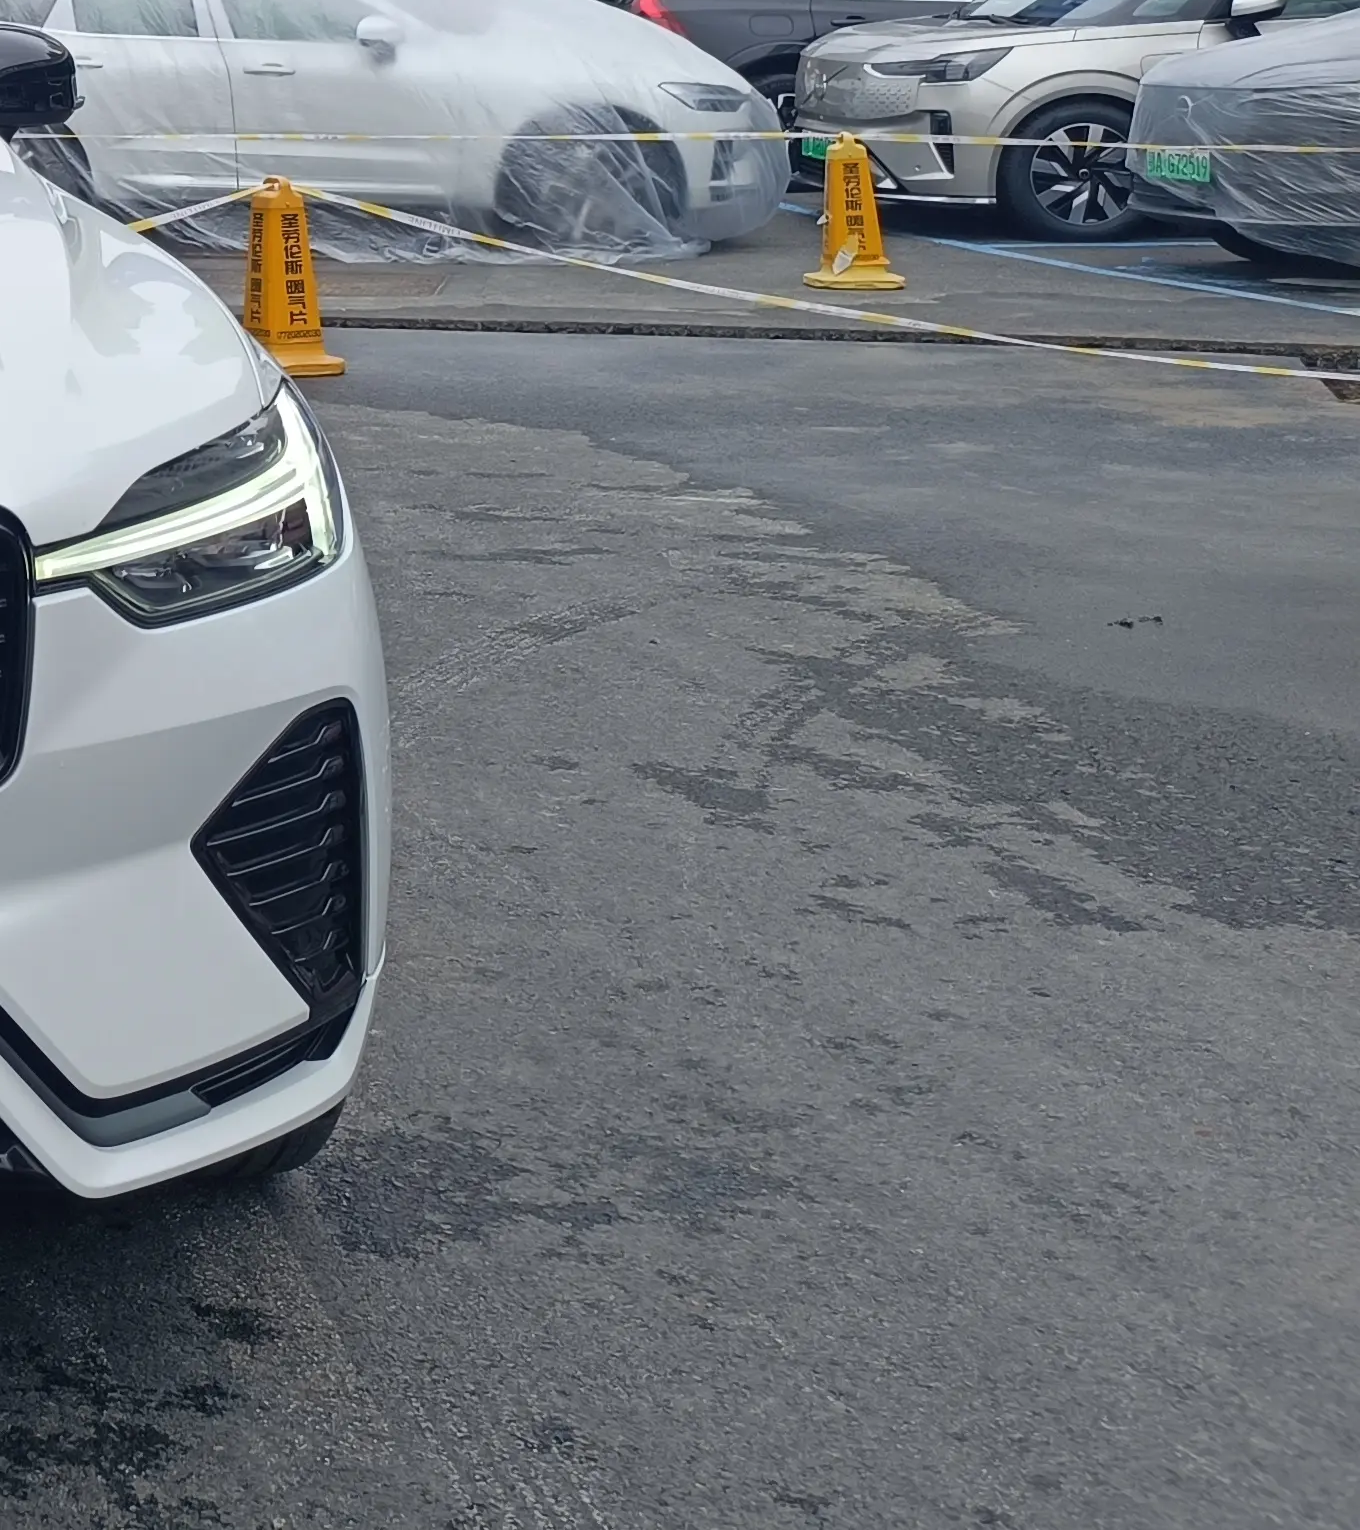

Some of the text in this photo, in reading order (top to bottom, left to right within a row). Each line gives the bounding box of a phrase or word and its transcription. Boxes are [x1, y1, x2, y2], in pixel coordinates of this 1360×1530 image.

[842, 162, 862, 211] 圣劳伦斯
[281, 213, 303, 276] 圣劳伦斯
[285, 278, 308, 326] 暖气片
